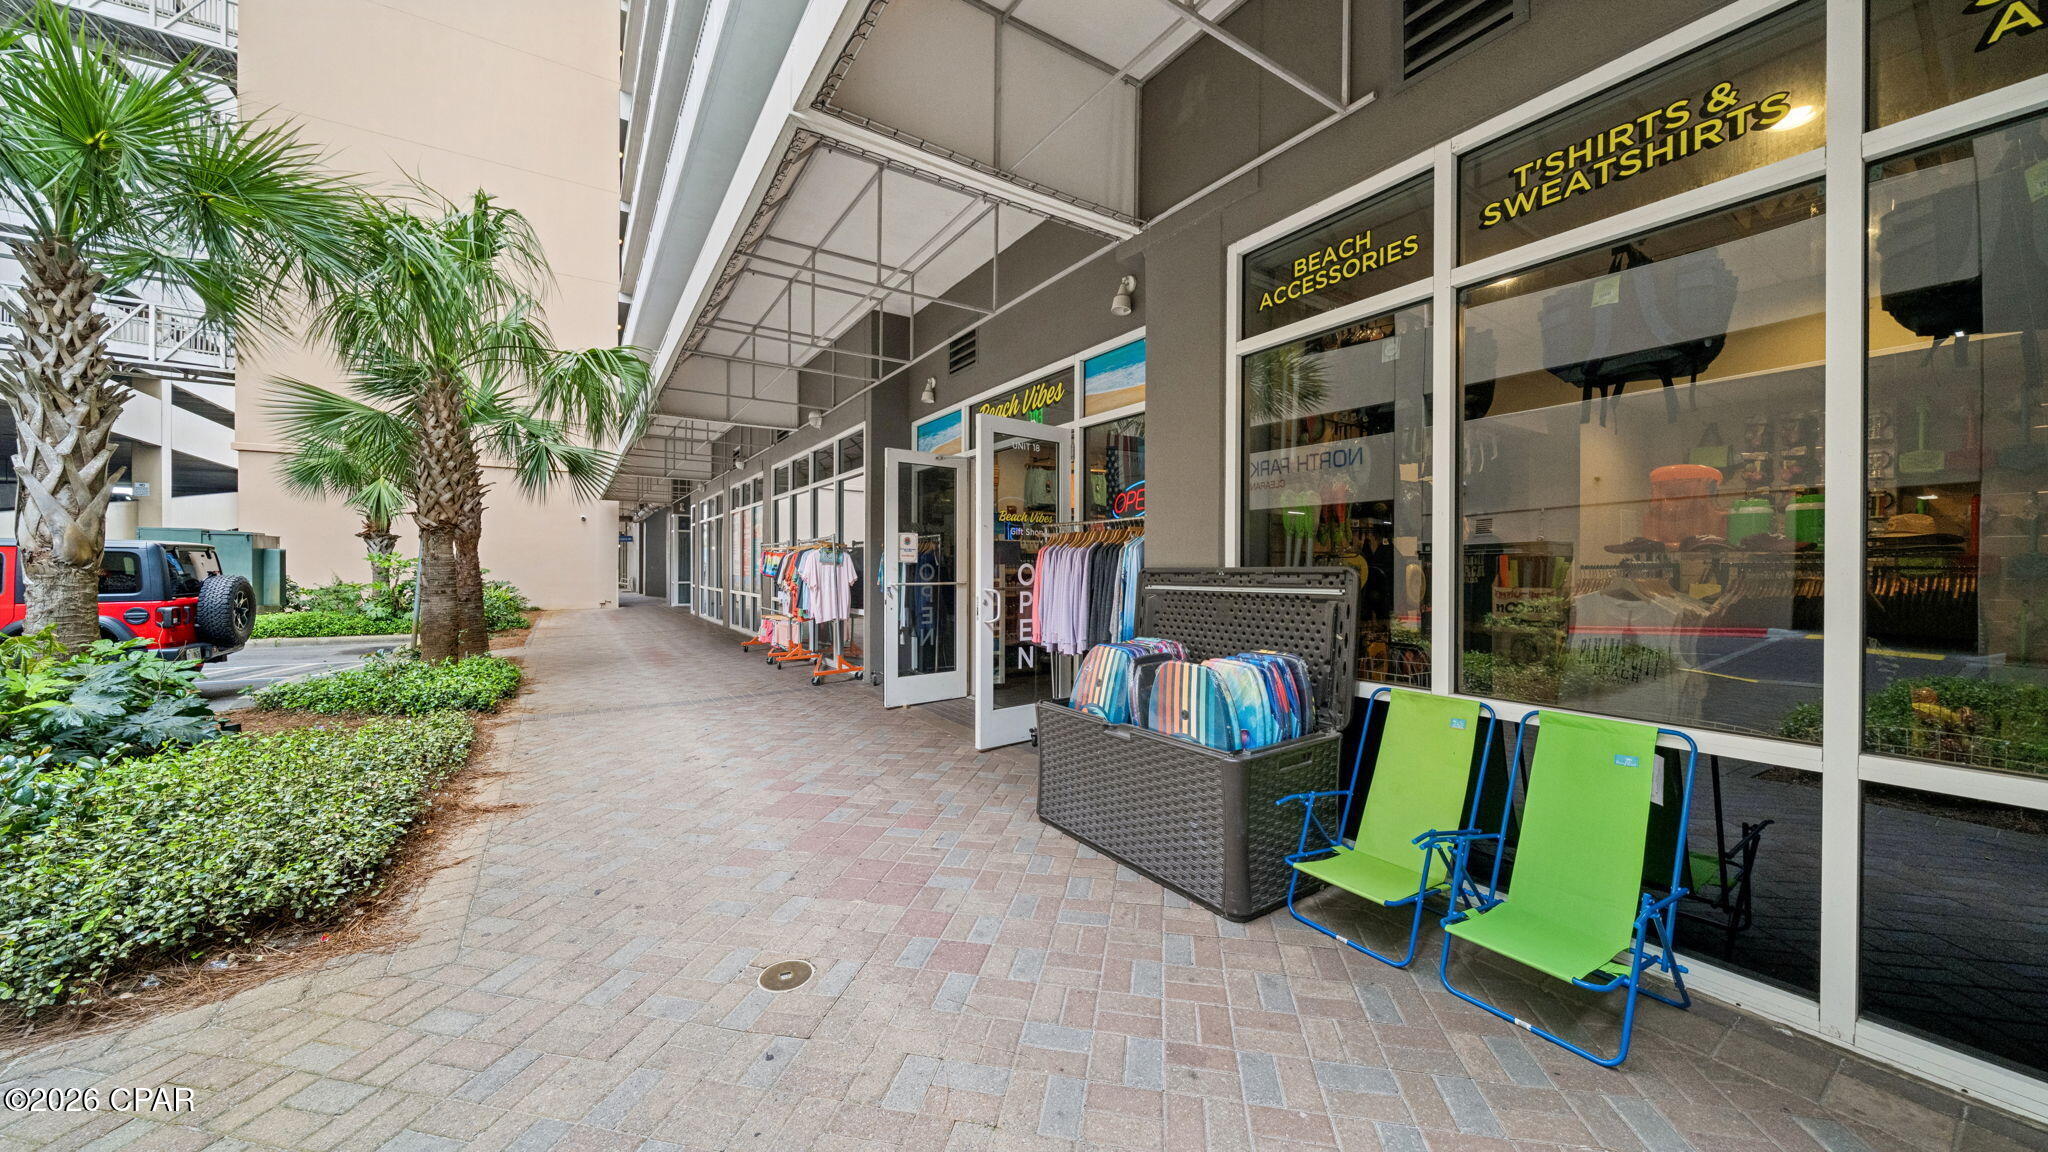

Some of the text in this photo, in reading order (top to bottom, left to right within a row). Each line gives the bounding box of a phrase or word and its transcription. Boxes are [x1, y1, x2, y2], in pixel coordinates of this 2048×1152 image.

[1707, 82, 1738, 113] &
[1483, 92, 1791, 226] SWEATSHIRTS
[1294, 230, 1371, 278] BEACH
[1259, 235, 1419, 311] ACCESSORIES
[1022, 382, 1065, 414] Vibes
[1012, 442, 1040, 452] UNIT 18
[999, 510, 1053, 523] Beach Vibes
[1114, 488, 1145, 514] OPE
[1010, 527, 1024, 536] Gift
[1018, 563, 1036, 669] OPEN
